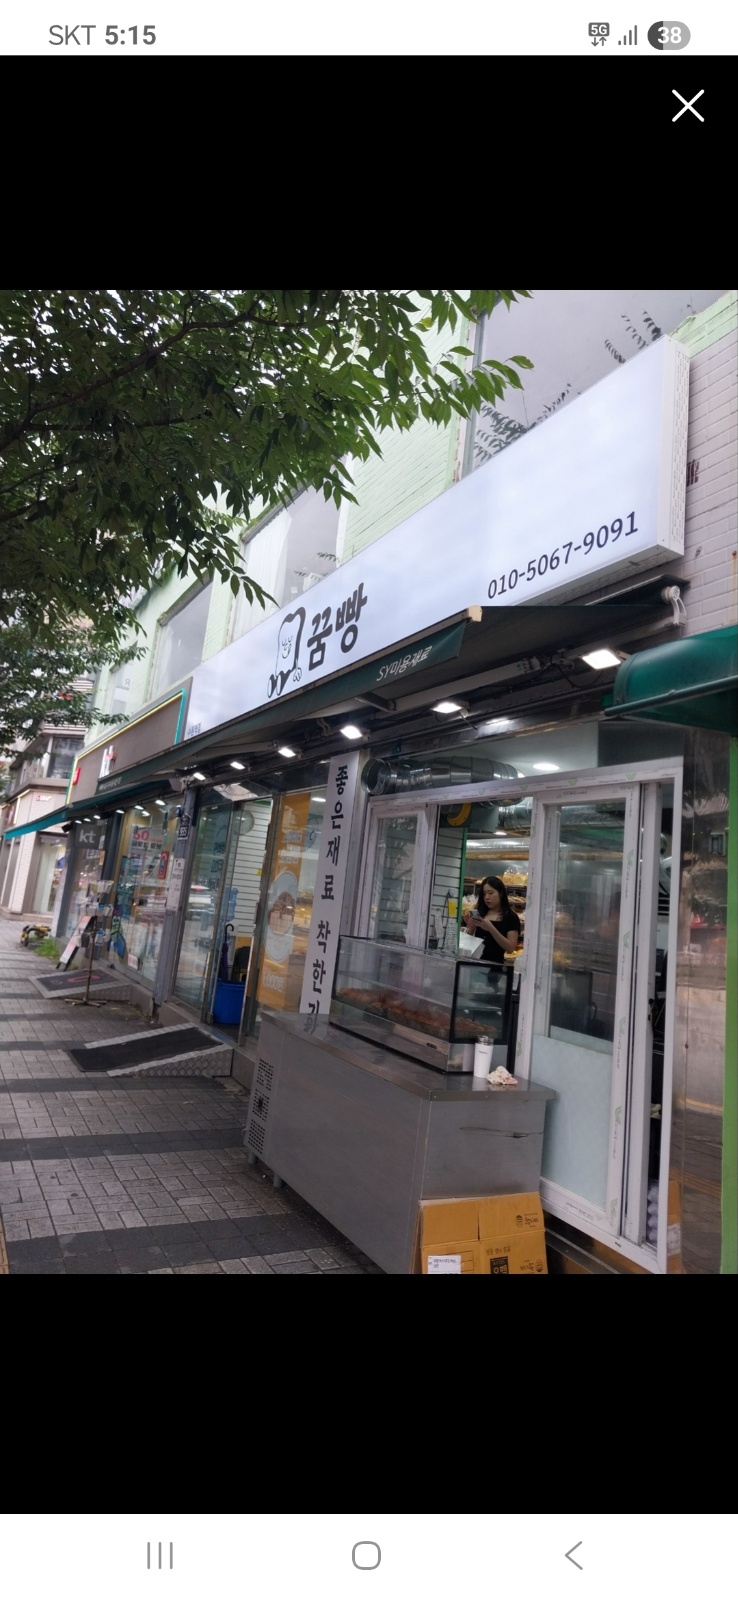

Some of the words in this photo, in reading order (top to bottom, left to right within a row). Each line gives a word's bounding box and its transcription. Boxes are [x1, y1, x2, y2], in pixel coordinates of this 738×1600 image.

[487, 511, 639, 600] 010-5067-9091
[307, 582, 368, 671] 꿈빵
[376, 645, 433, 682] SY미용재료
[79, 829, 96, 844] kt
